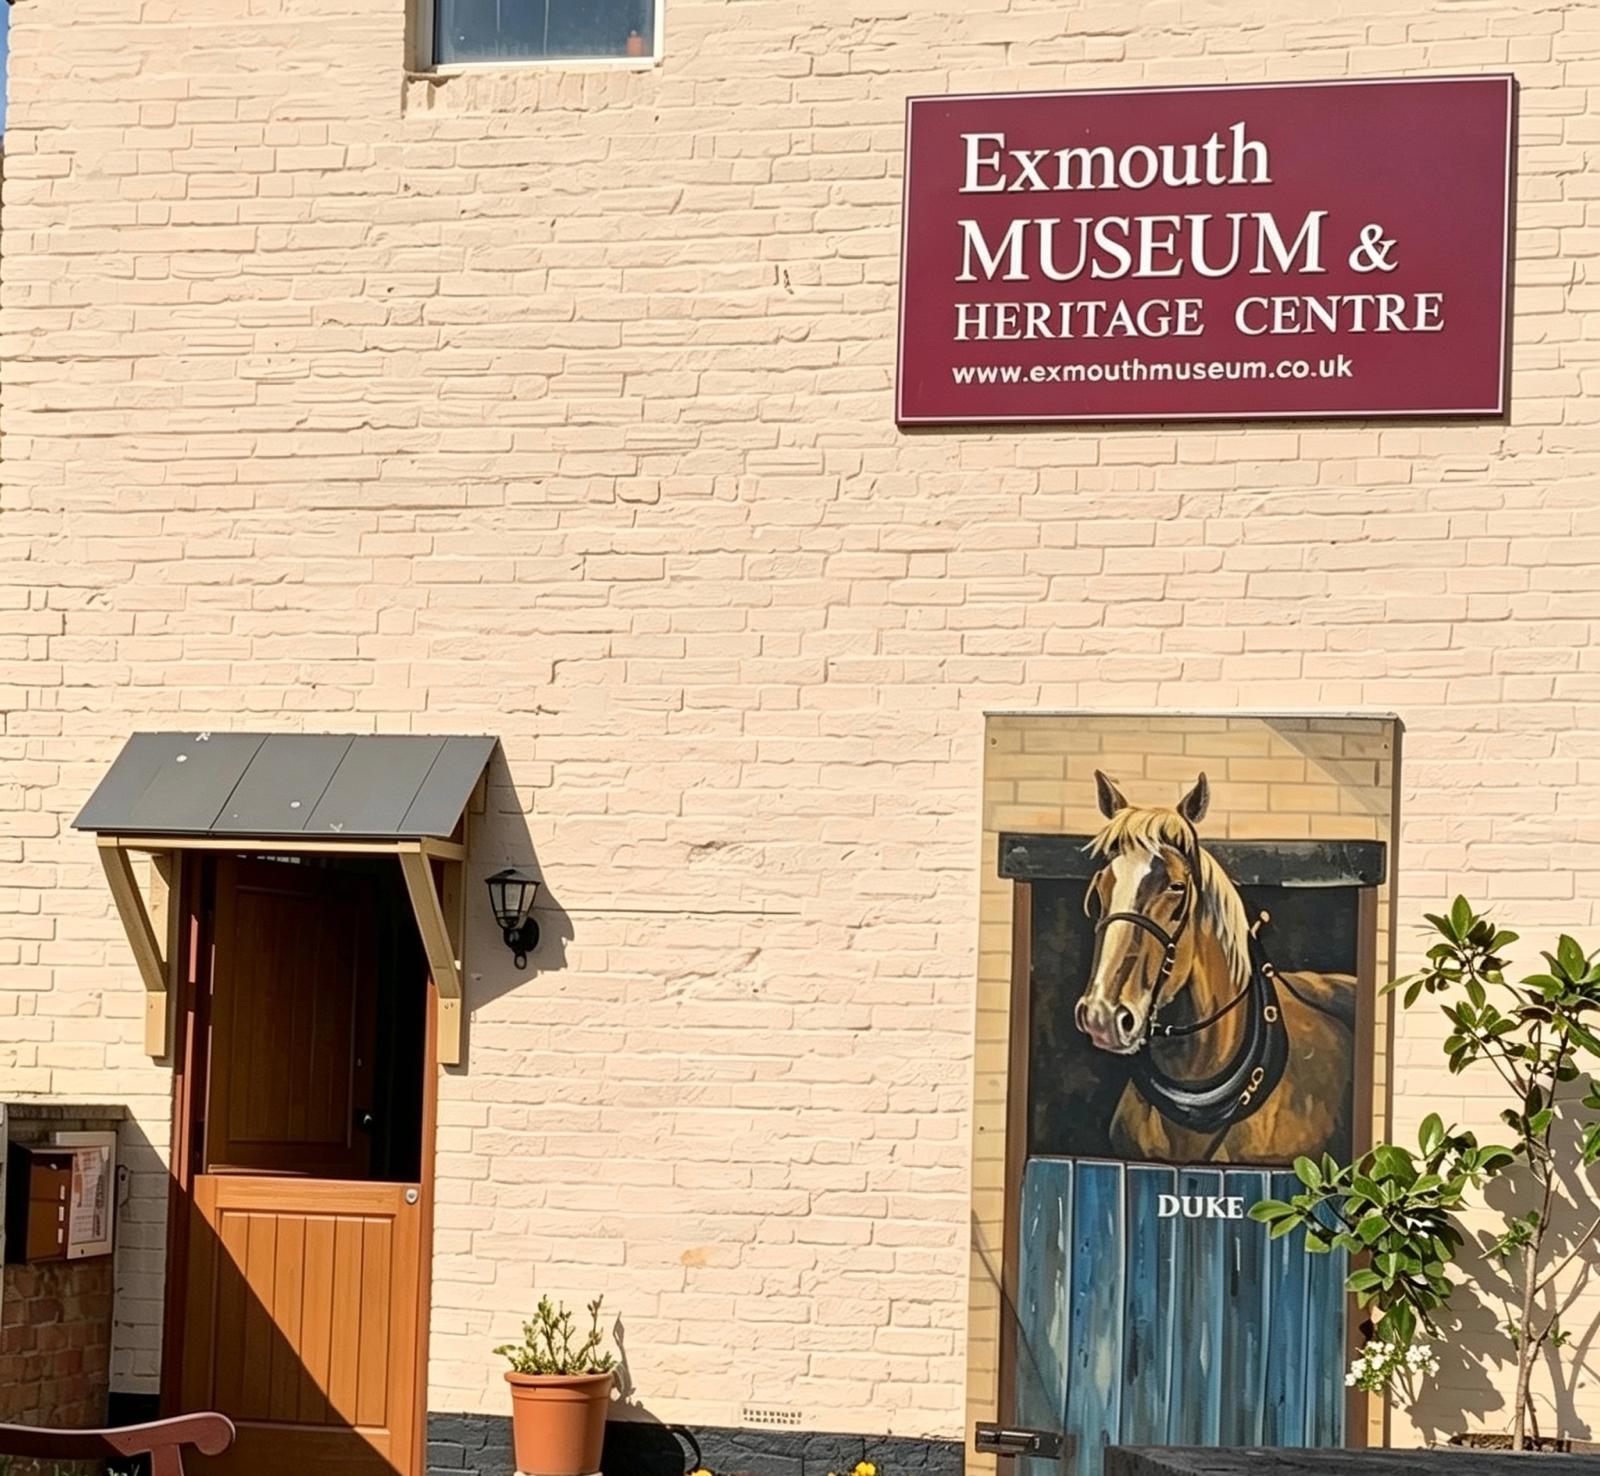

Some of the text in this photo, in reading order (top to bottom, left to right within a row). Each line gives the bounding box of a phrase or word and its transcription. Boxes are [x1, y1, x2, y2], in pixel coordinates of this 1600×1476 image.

[958, 121, 1272, 193] Exmouth
[955, 210, 1398, 281] MUSEUM &
[953, 292, 1444, 340] HERITAGE CENTRE
[952, 354, 1353, 384] www.exmouthmuseum.co.uk
[1158, 1194, 1244, 1219] DUKE
